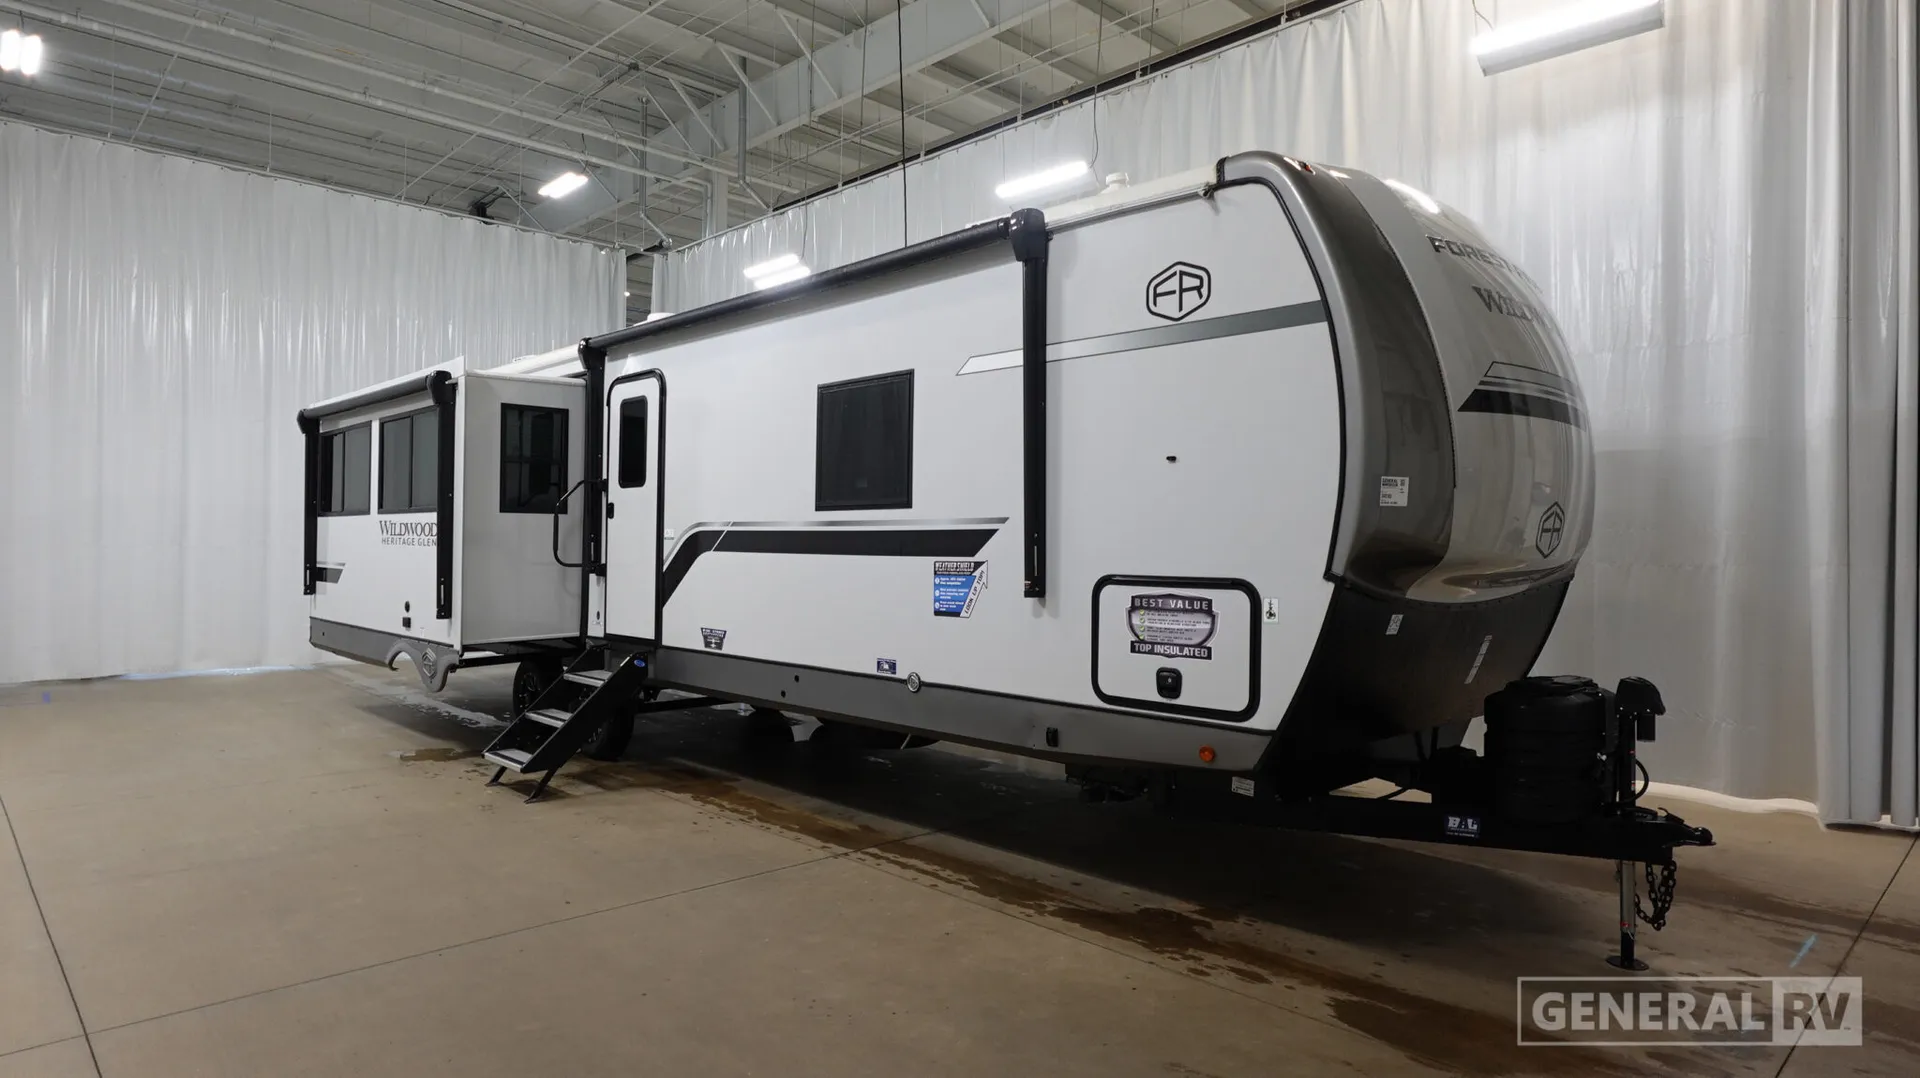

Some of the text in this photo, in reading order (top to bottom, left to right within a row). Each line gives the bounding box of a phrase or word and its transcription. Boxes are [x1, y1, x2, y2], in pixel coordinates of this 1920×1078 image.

[379, 520, 437, 537] WILDWOOD
[381, 537, 437, 547] HERITAGE GLEN
[1134, 598, 1209, 610] BEST VALUE
[1133, 643, 1208, 657] TOP INSULATED
